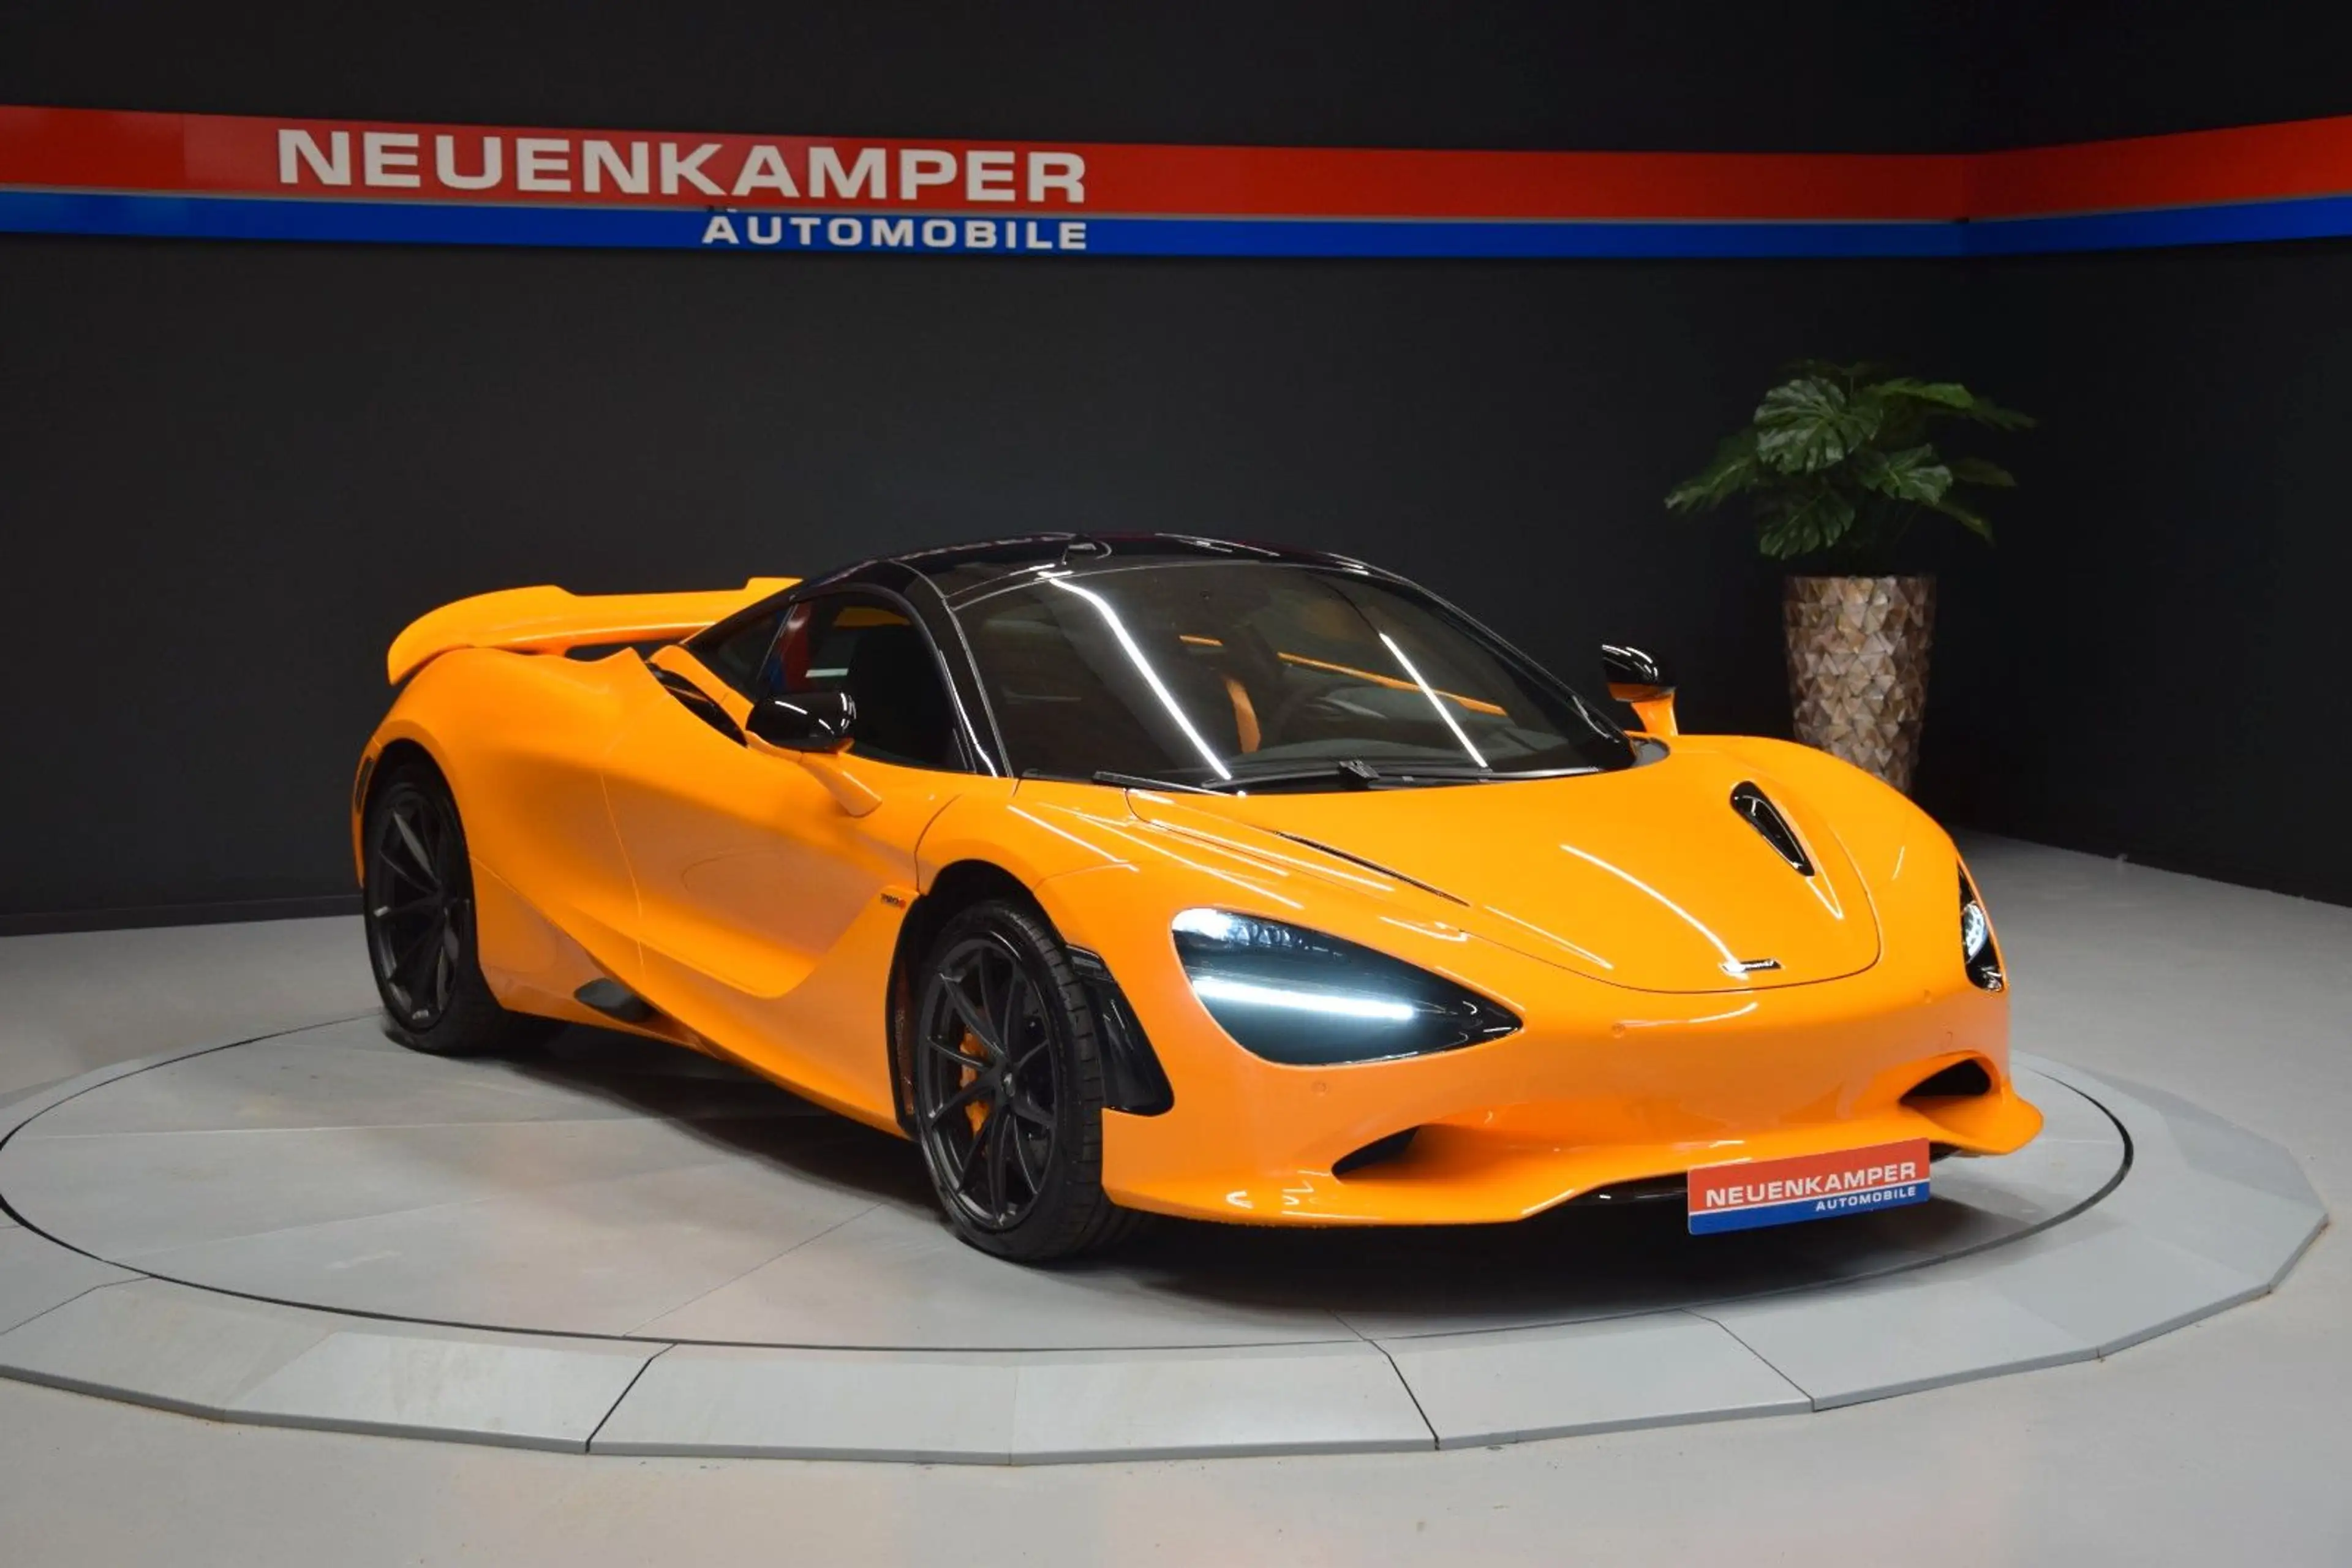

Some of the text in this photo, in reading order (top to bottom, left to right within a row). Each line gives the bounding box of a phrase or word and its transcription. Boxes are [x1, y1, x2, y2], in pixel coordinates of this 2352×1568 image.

[277, 129, 1085, 203] NEUENKAMPER
[702, 216, 1087, 249] AUTOMOBILE
[1706, 1162, 1916, 1207] NEUENKAMPER
[1815, 1186, 1916, 1212] AUTOMOBILE
